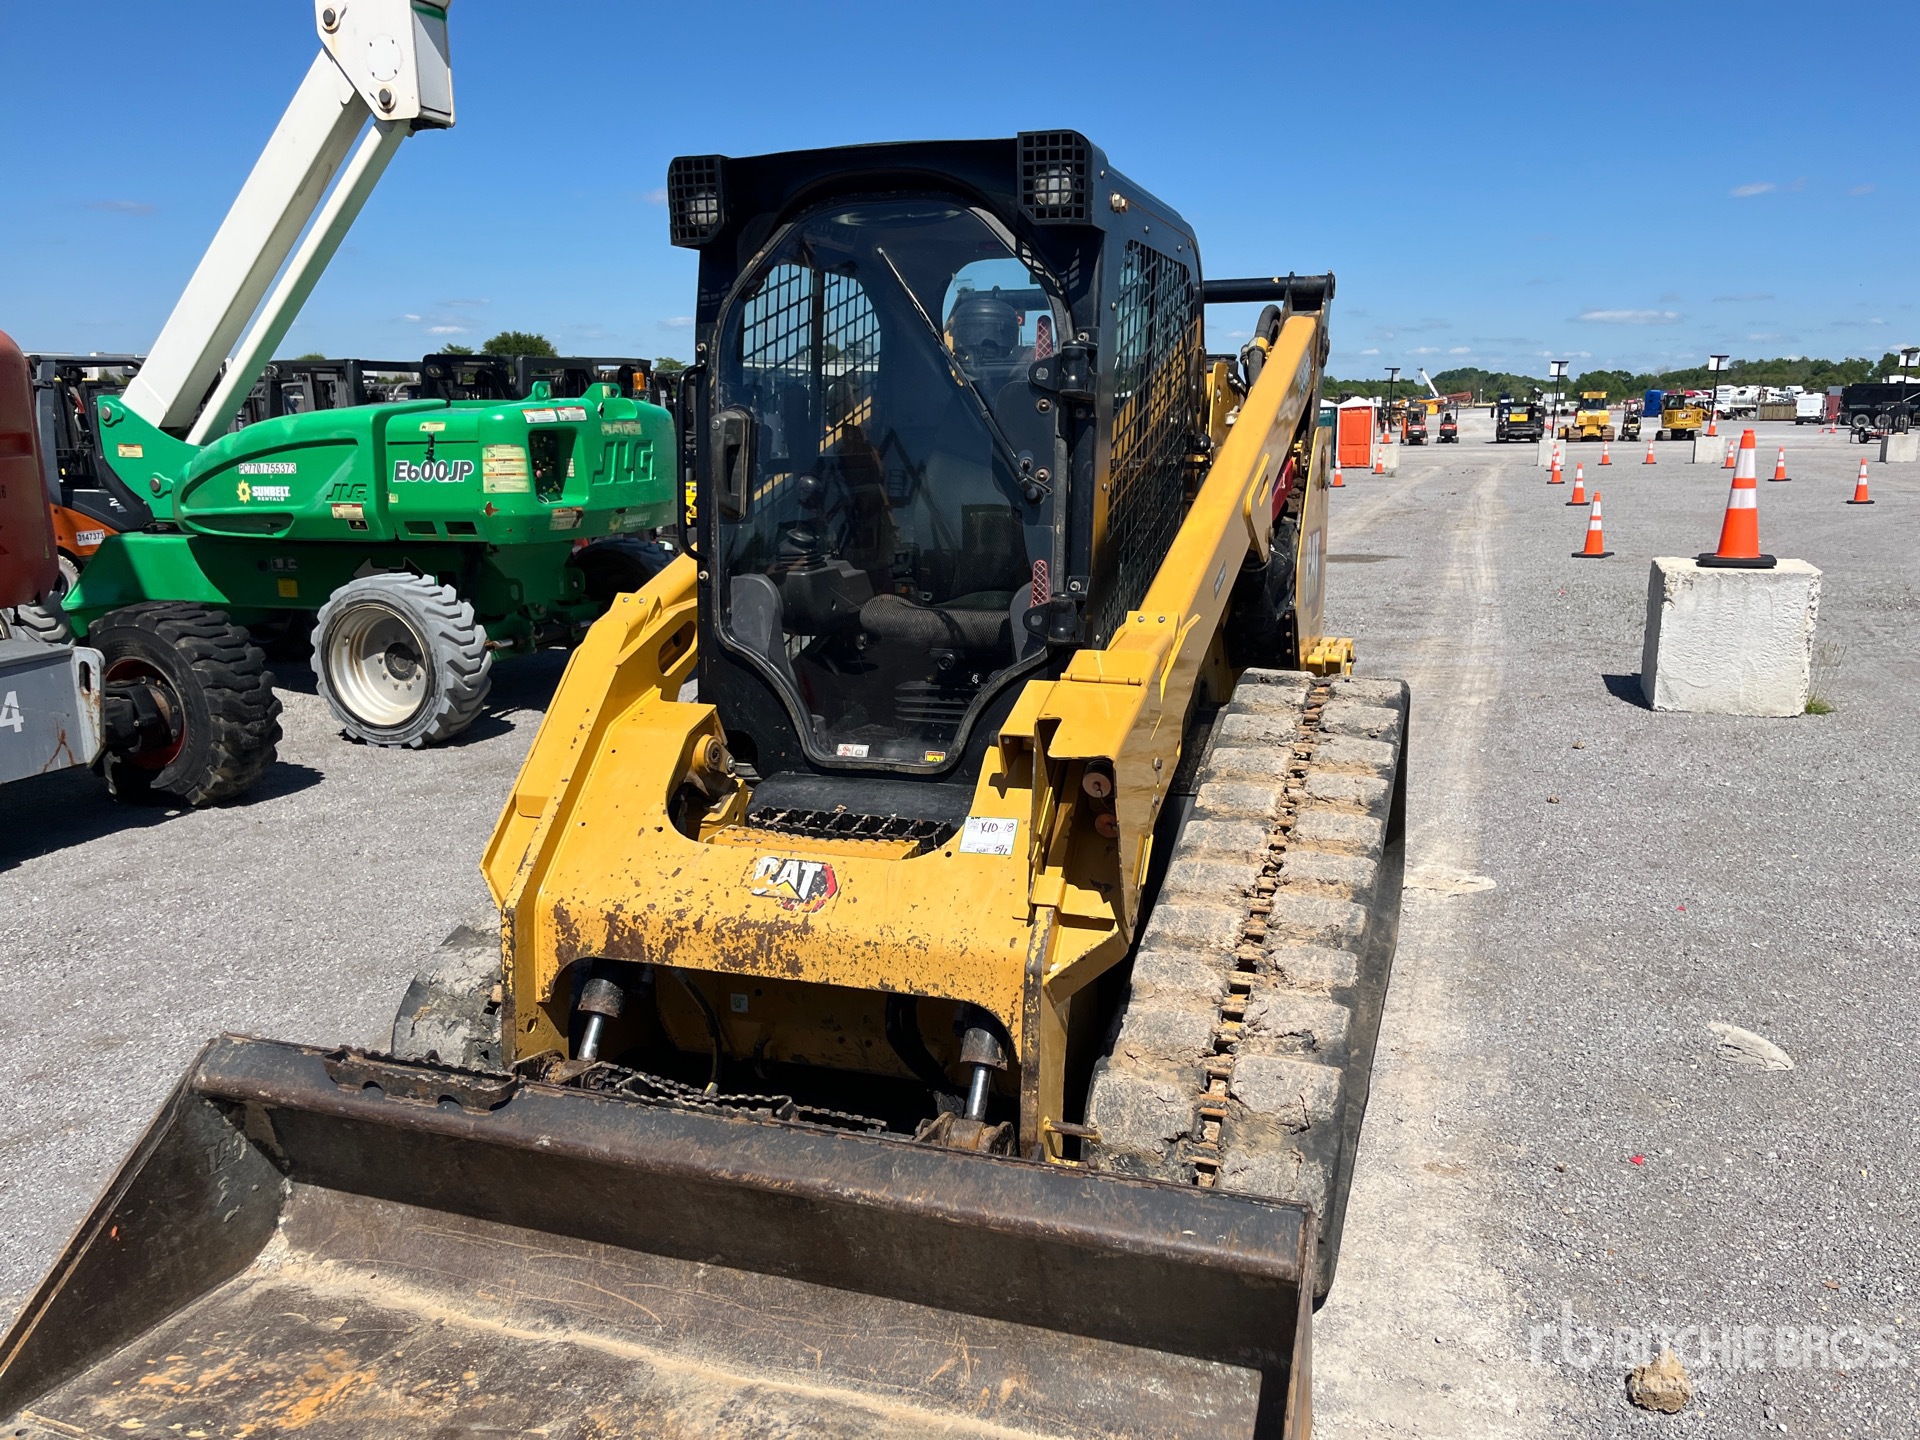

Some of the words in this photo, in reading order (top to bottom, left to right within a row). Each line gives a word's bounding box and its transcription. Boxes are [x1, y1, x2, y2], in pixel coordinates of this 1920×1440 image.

[393, 459, 474, 483] E600JP
[592, 440, 656, 486] JLG
[252, 486, 290, 497] SUNBELT
[326, 484, 367, 503] JLG
[0, 690, 25, 733] 4
